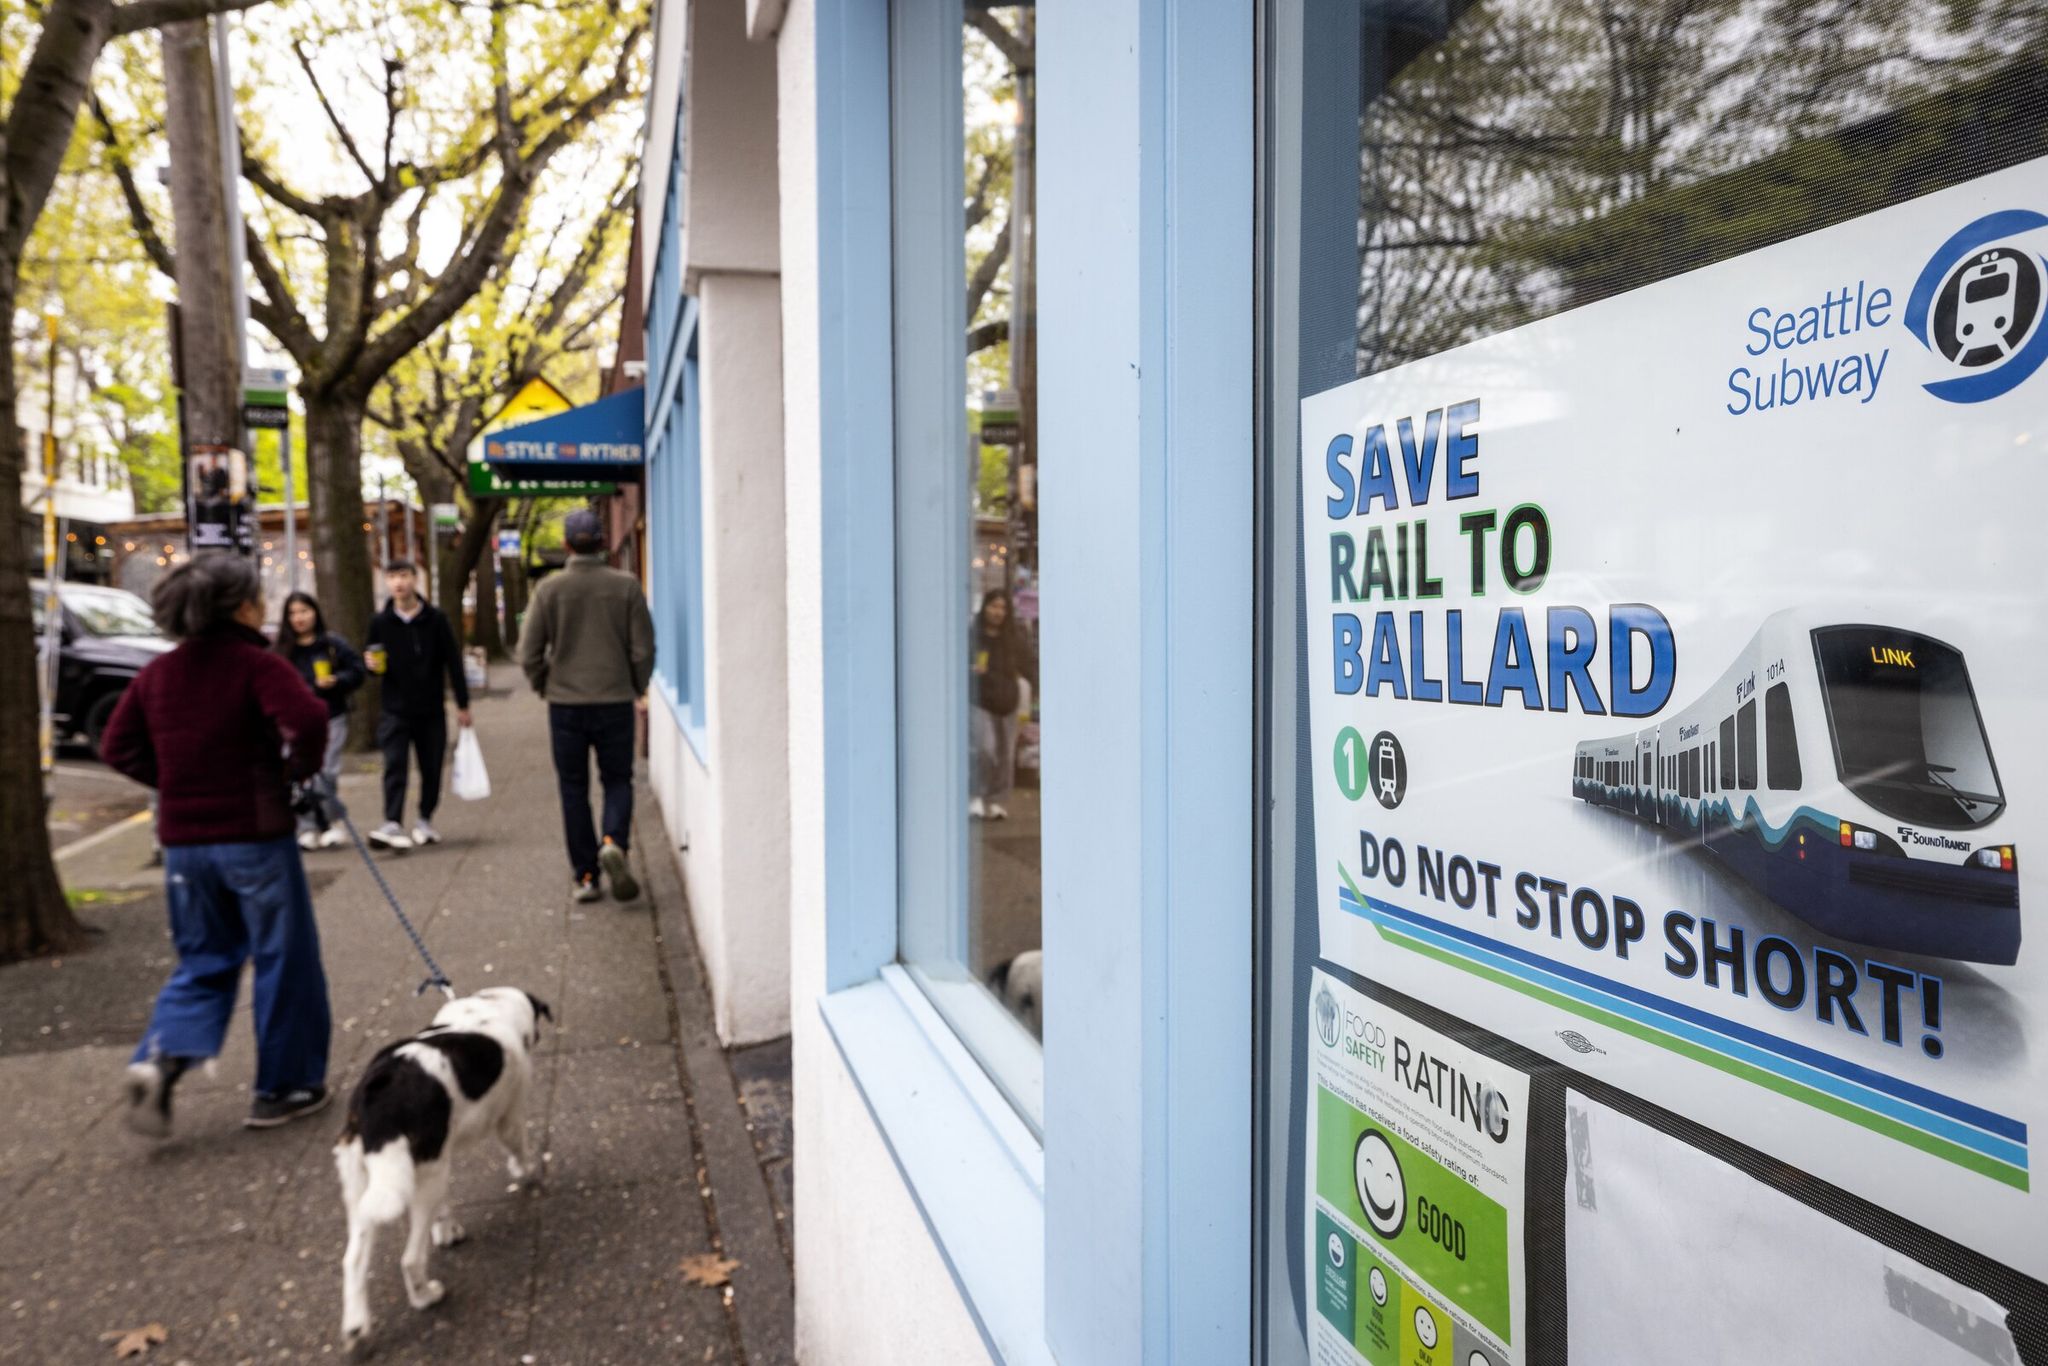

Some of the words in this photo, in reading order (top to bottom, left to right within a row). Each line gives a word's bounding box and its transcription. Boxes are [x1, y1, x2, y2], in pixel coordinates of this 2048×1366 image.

[1745, 280, 1893, 356] Seattle
[1726, 348, 1890, 416] Subway
[1326, 397, 1481, 520] SAVE
[1329, 518, 1444, 603] RAIL
[1459, 502, 1552, 597] TO
[1332, 602, 1677, 719] BALLARD
[1766, 658, 1786, 682] 101A
[1871, 646, 1916, 669] LINK
[1341, 736, 1356, 791] 1
[1359, 829, 1407, 888] DO
[1416, 844, 1503, 911] NOT
[1515, 870, 1646, 960] STOP
[1663, 909, 1945, 1060] SHORT!
[1345, 1010, 1386, 1048] FOOD
[1345, 1035, 1386, 1074] SAFETY
[1394, 1035, 1509, 1144] RATING
[1355, 1096, 1366, 1112] has
[1368, 1106, 1396, 1131] received
[1403, 1126, 1418, 1147] food
[1420, 1140, 1442, 1166] safety
[1444, 1155, 1466, 1181] rating
[1468, 1172, 1479, 1188] of:
[1417, 1195, 1467, 1262] GOOD
